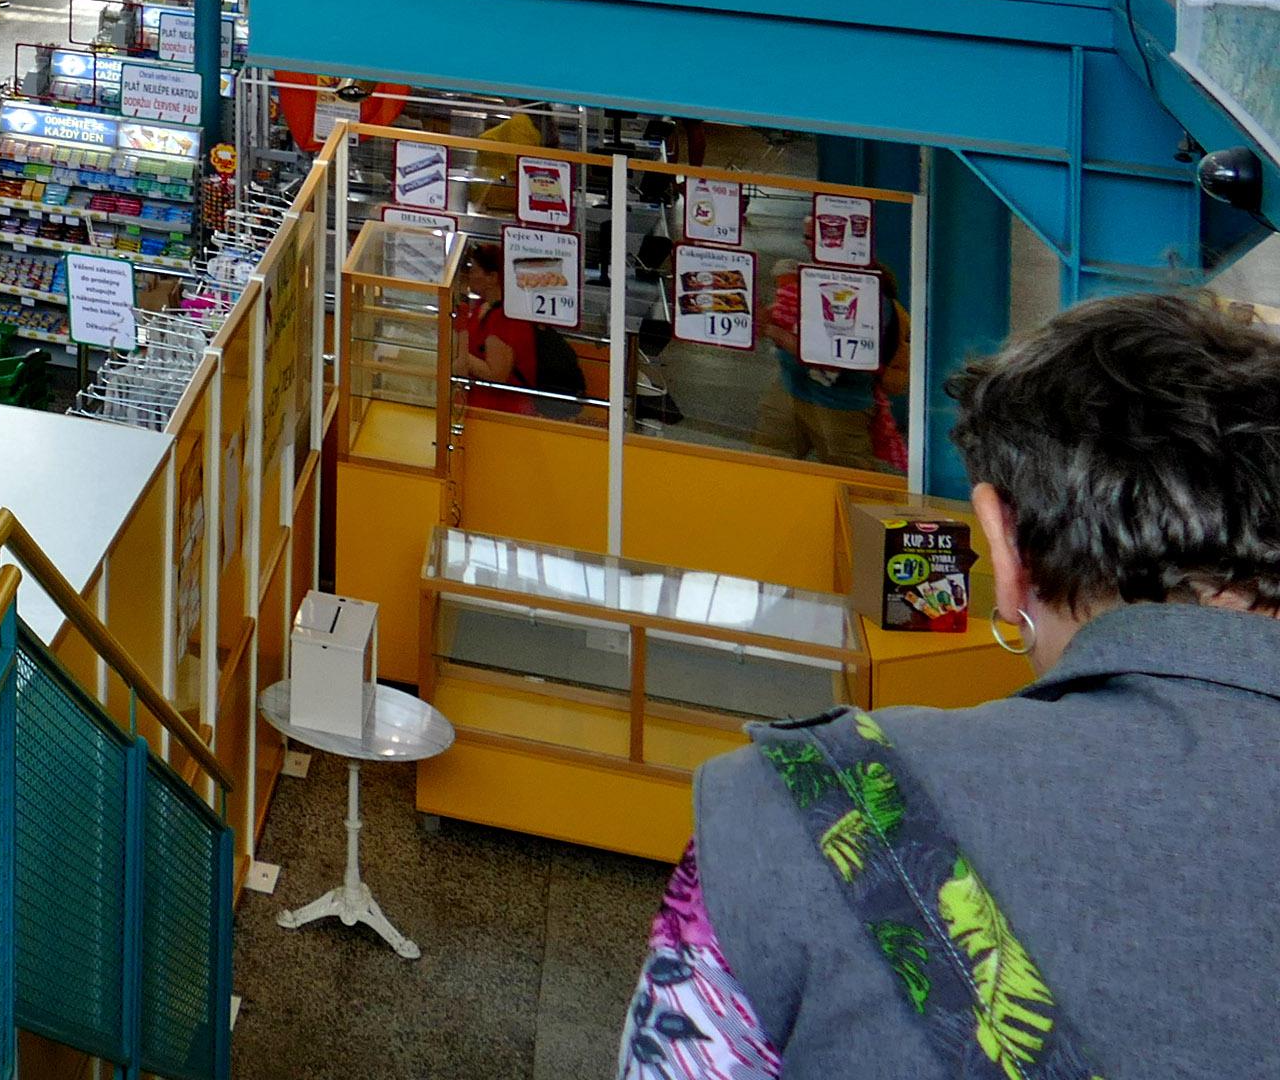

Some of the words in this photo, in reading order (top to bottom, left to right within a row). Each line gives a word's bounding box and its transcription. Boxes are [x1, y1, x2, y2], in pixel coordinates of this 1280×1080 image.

[124, 81, 140, 92] PLAŤ
[143, 83, 170, 96] NEJLÉPE
[171, 87, 199, 100] KARTOU
[44, 126, 80, 140] KAŽDÝ
[82, 131, 104, 143] DEN
[401, 213, 437, 225] DELISSA
[535, 295, 557, 316] 21
[560, 297, 574, 308] 90
[709, 316, 732, 336] 19
[834, 338, 858, 360] 17
[903, 533, 924, 548] KUP
[927, 534, 935, 548] 3
[938, 534, 952, 548] KS
